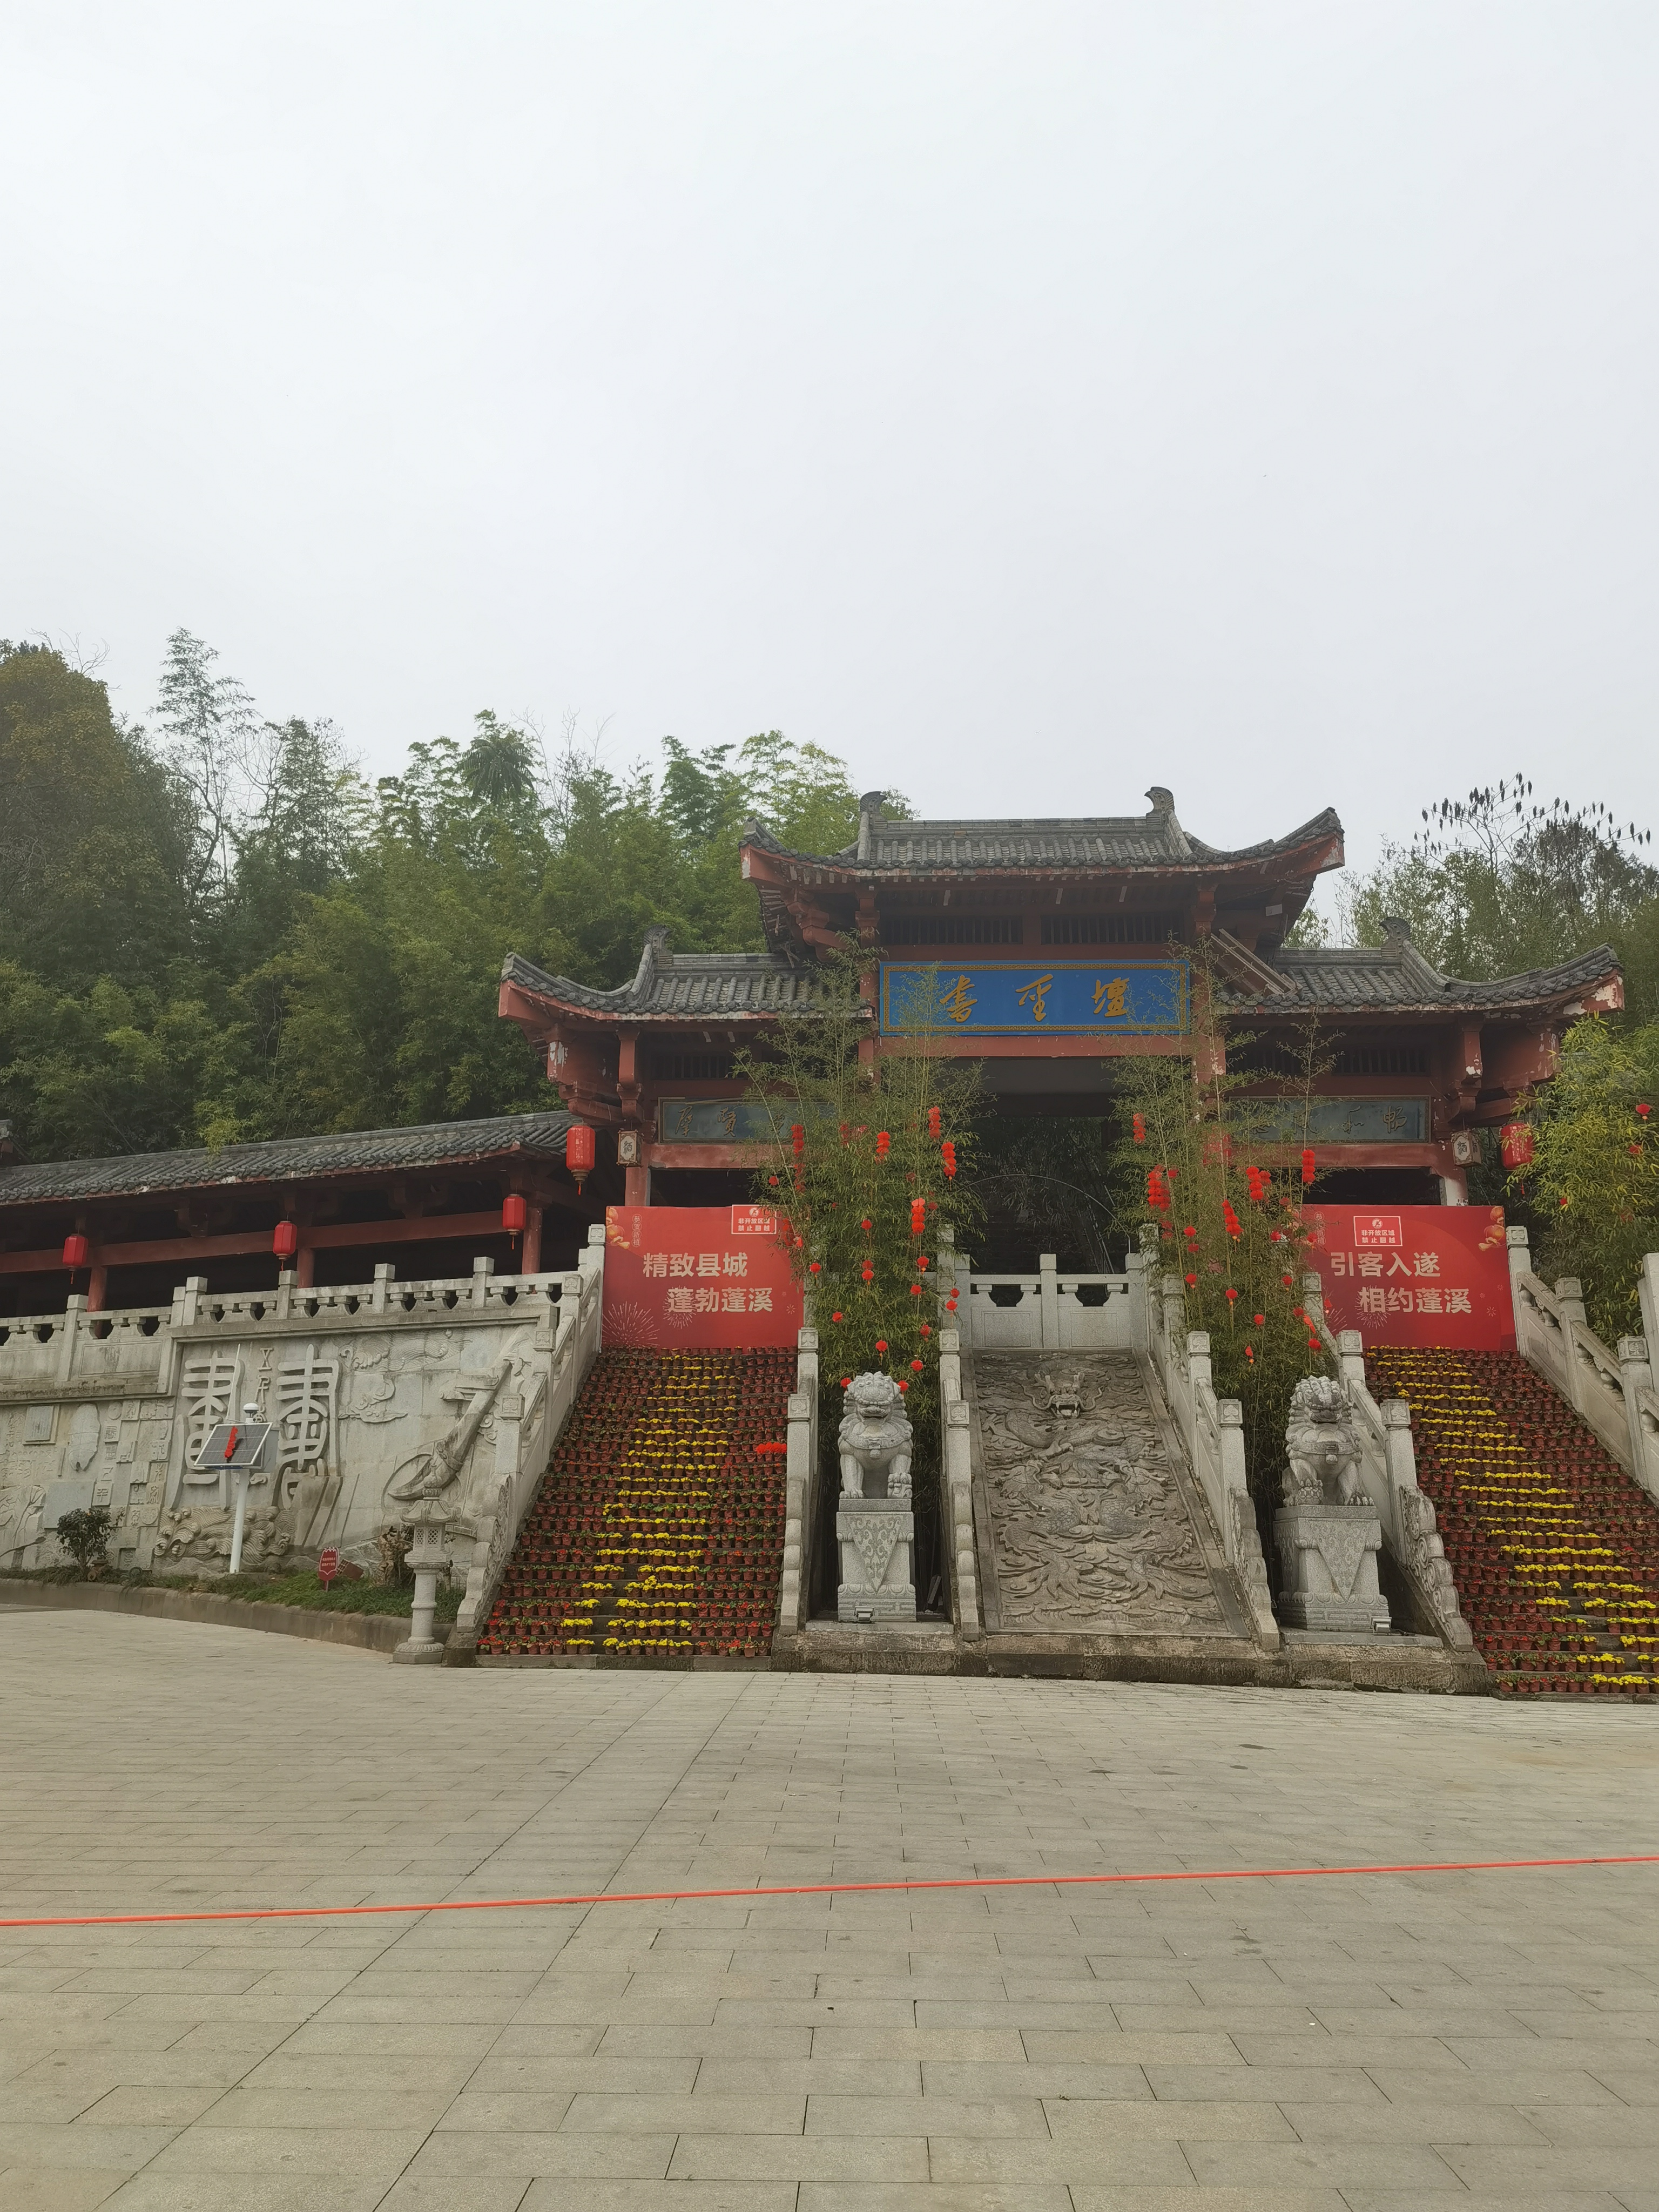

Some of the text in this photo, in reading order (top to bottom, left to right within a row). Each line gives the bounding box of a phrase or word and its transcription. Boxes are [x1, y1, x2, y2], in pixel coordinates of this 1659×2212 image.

[643, 1252, 748, 1278] 精致县城
[1330, 1251, 1441, 1277] 引客入遂
[667, 1287, 773, 1313] 蓬勃蓬溪
[1359, 1287, 1472, 1313] 相约蓬溪
